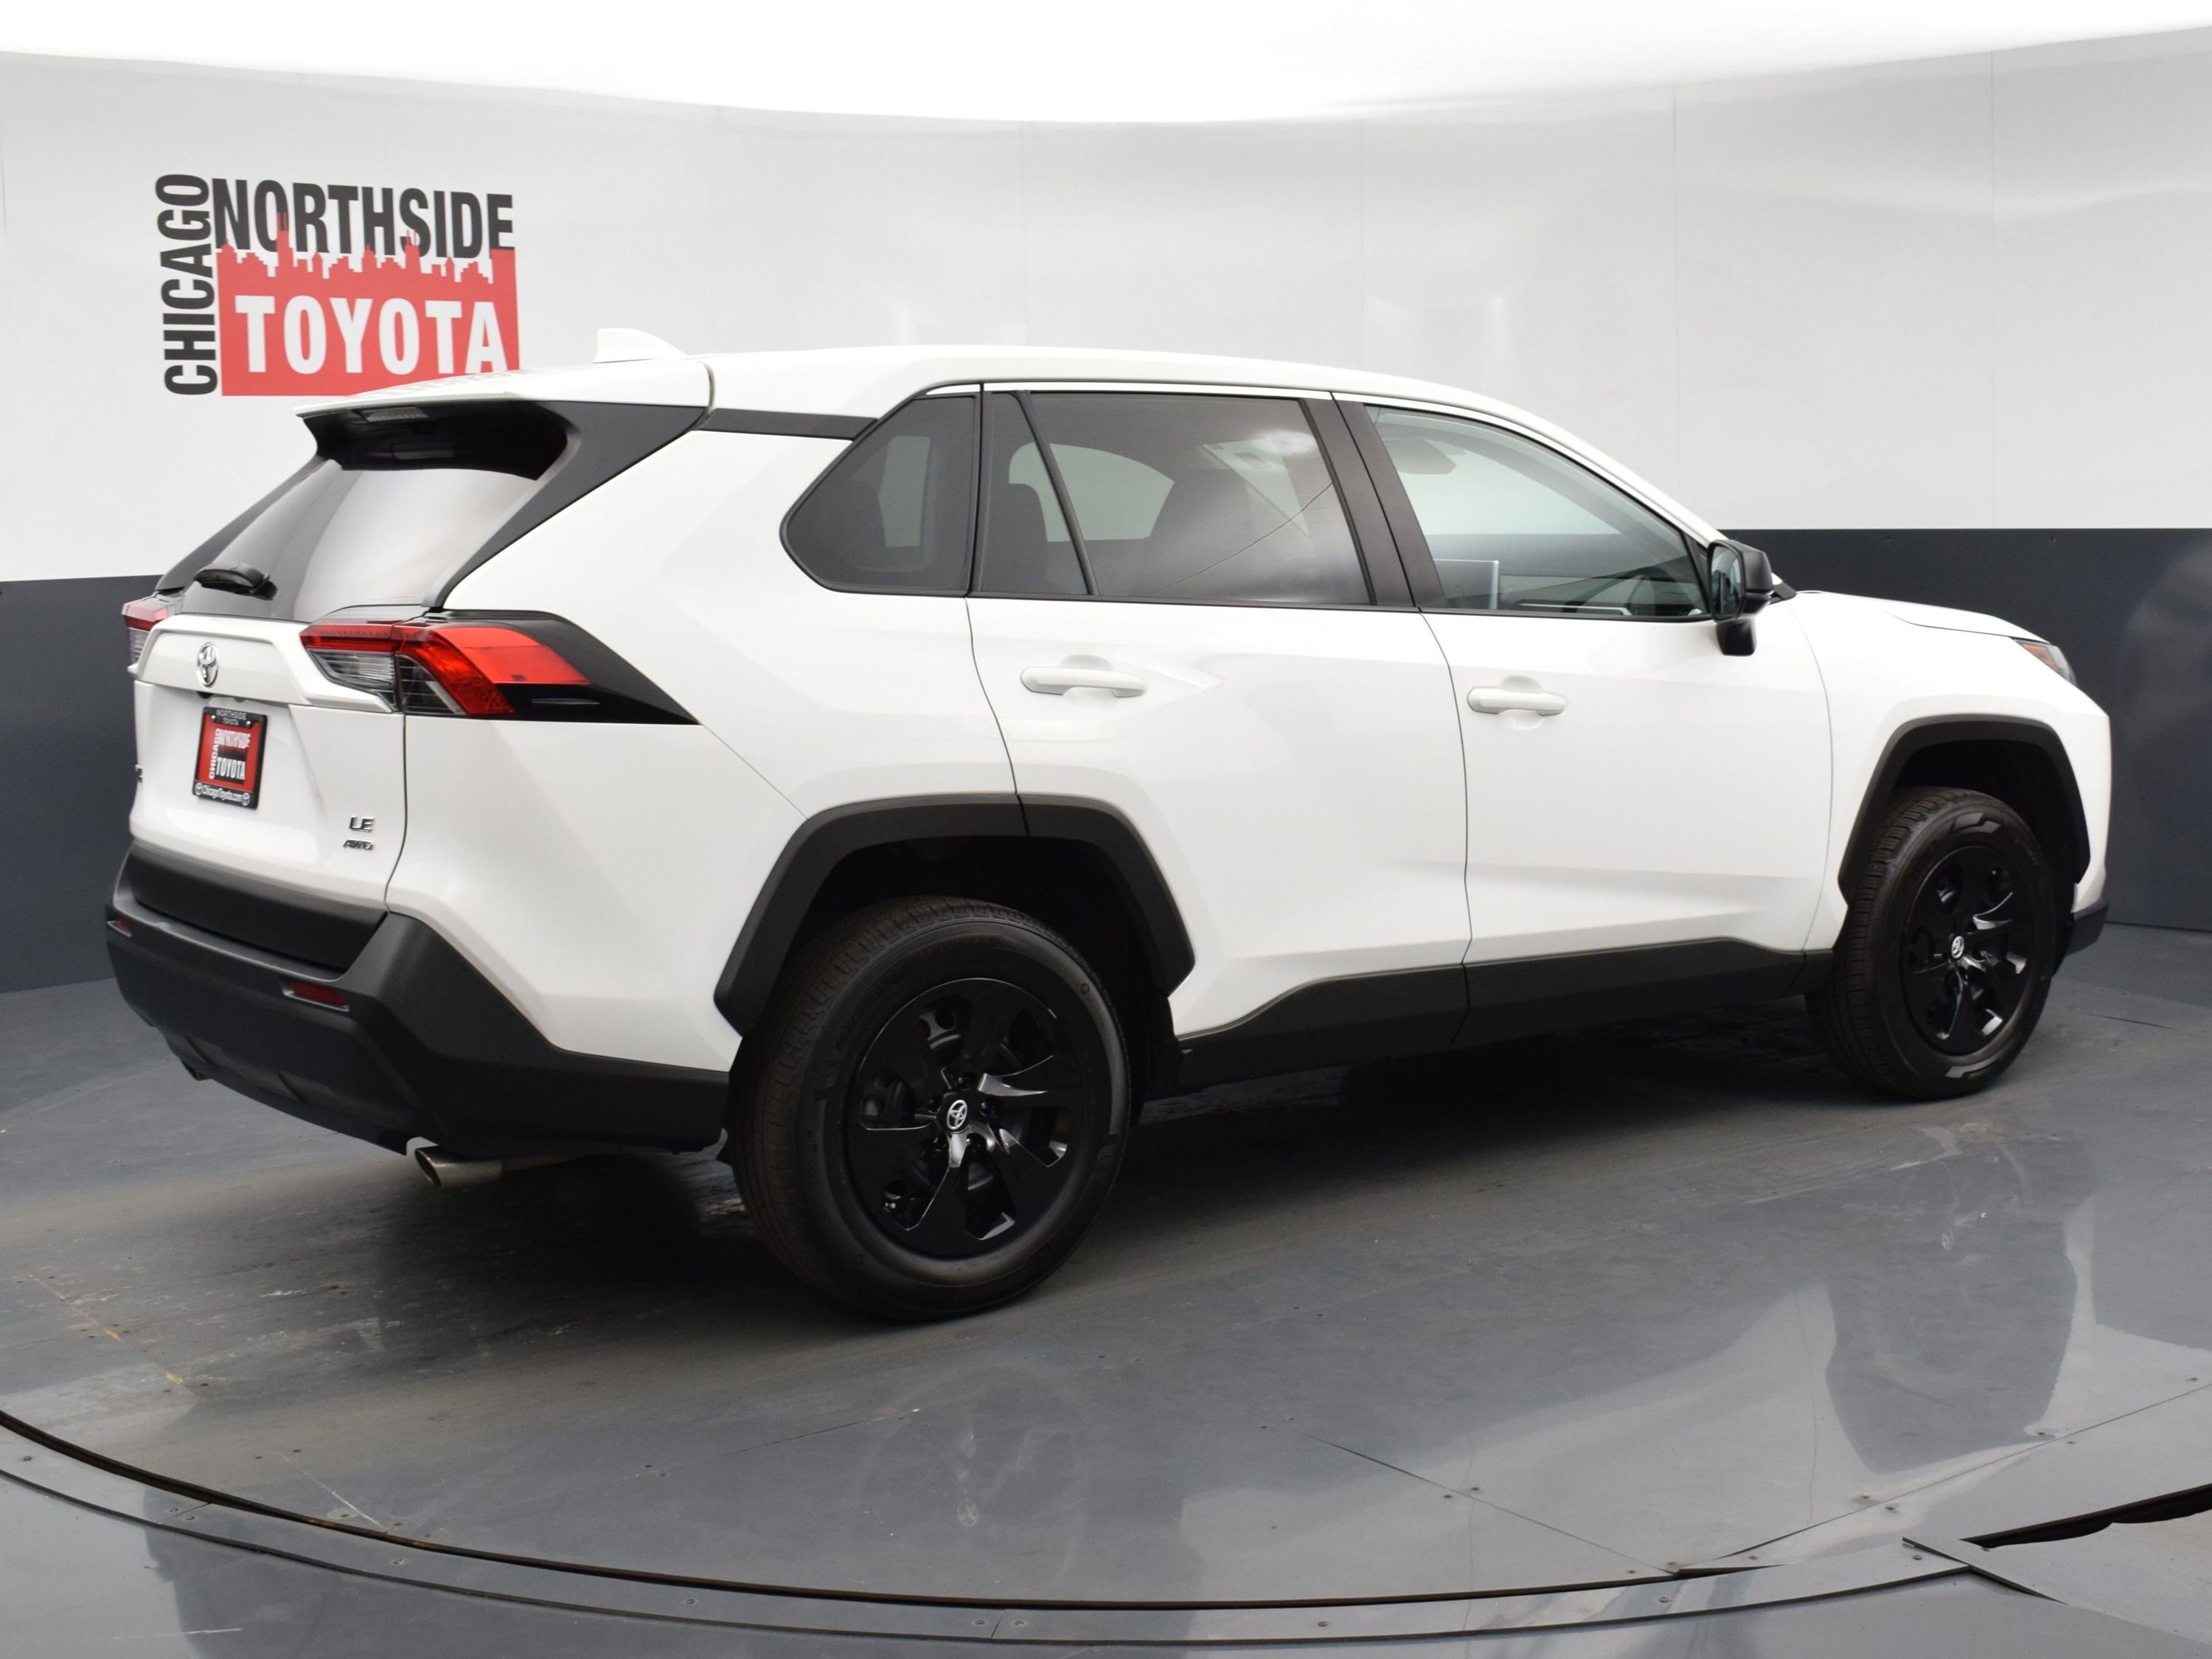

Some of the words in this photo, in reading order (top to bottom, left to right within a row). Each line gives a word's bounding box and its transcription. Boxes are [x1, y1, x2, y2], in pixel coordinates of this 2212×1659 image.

[212, 178, 515, 260] NORTHSIDE
[155, 174, 218, 395] CHICAGO
[234, 295, 508, 375] TOYOTA
[209, 728, 220, 779] CHICAGO
[215, 757, 246, 780] TOYOTA
[349, 815, 375, 832] LE
